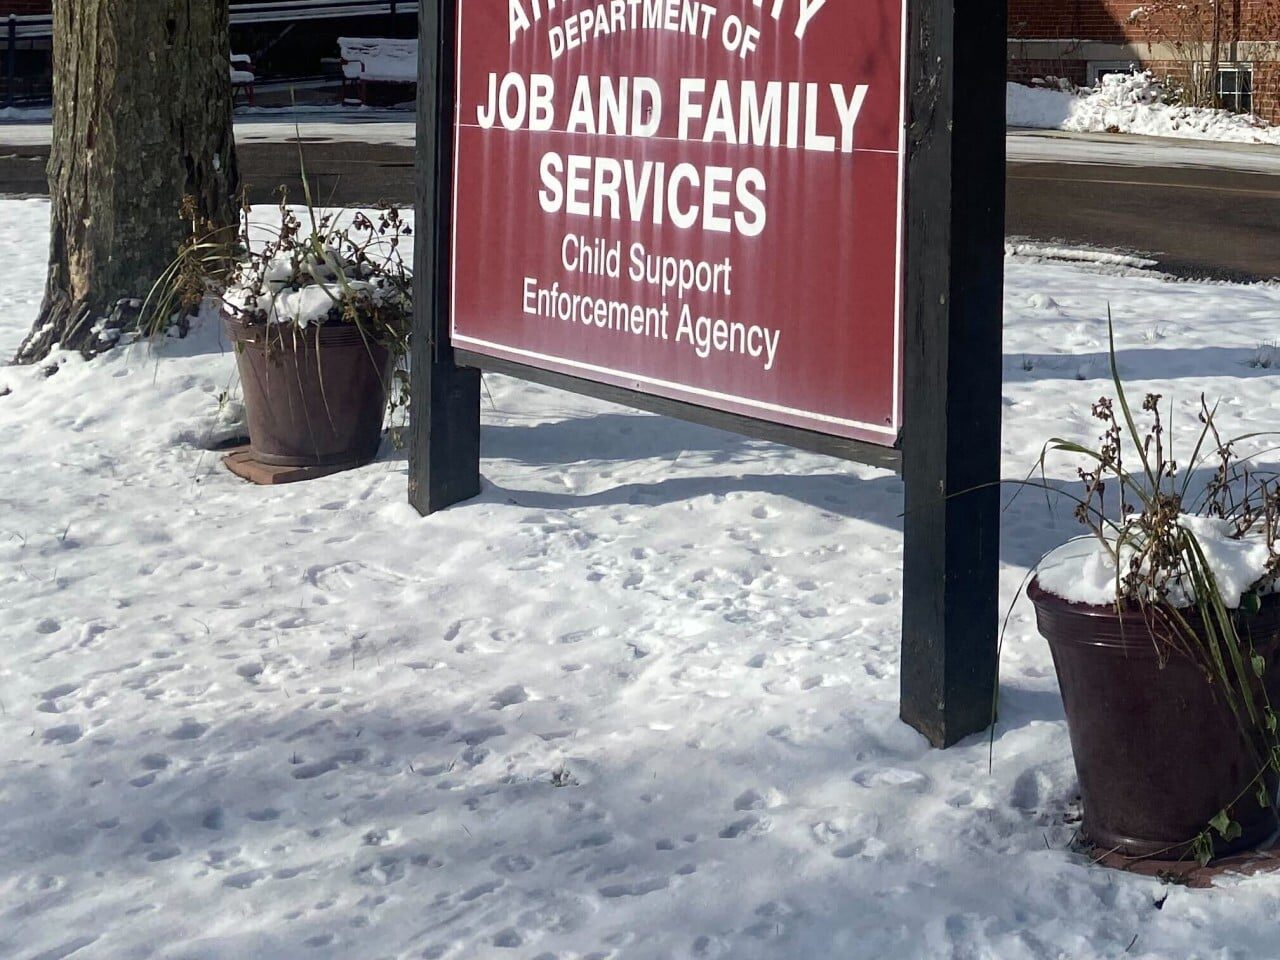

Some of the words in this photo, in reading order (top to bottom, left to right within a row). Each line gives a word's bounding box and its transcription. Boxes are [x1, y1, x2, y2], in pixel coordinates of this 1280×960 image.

[721, 15, 760, 59] OF
[477, 72, 555, 132] JOB
[566, 75, 662, 138] AND
[678, 78, 869, 153] FAMILY
[539, 151, 766, 237] SERVICES
[561, 233, 620, 278] Child
[628, 242, 732, 299] Support
[522, 277, 668, 340] Enforcement
[675, 303, 780, 370] Agency
